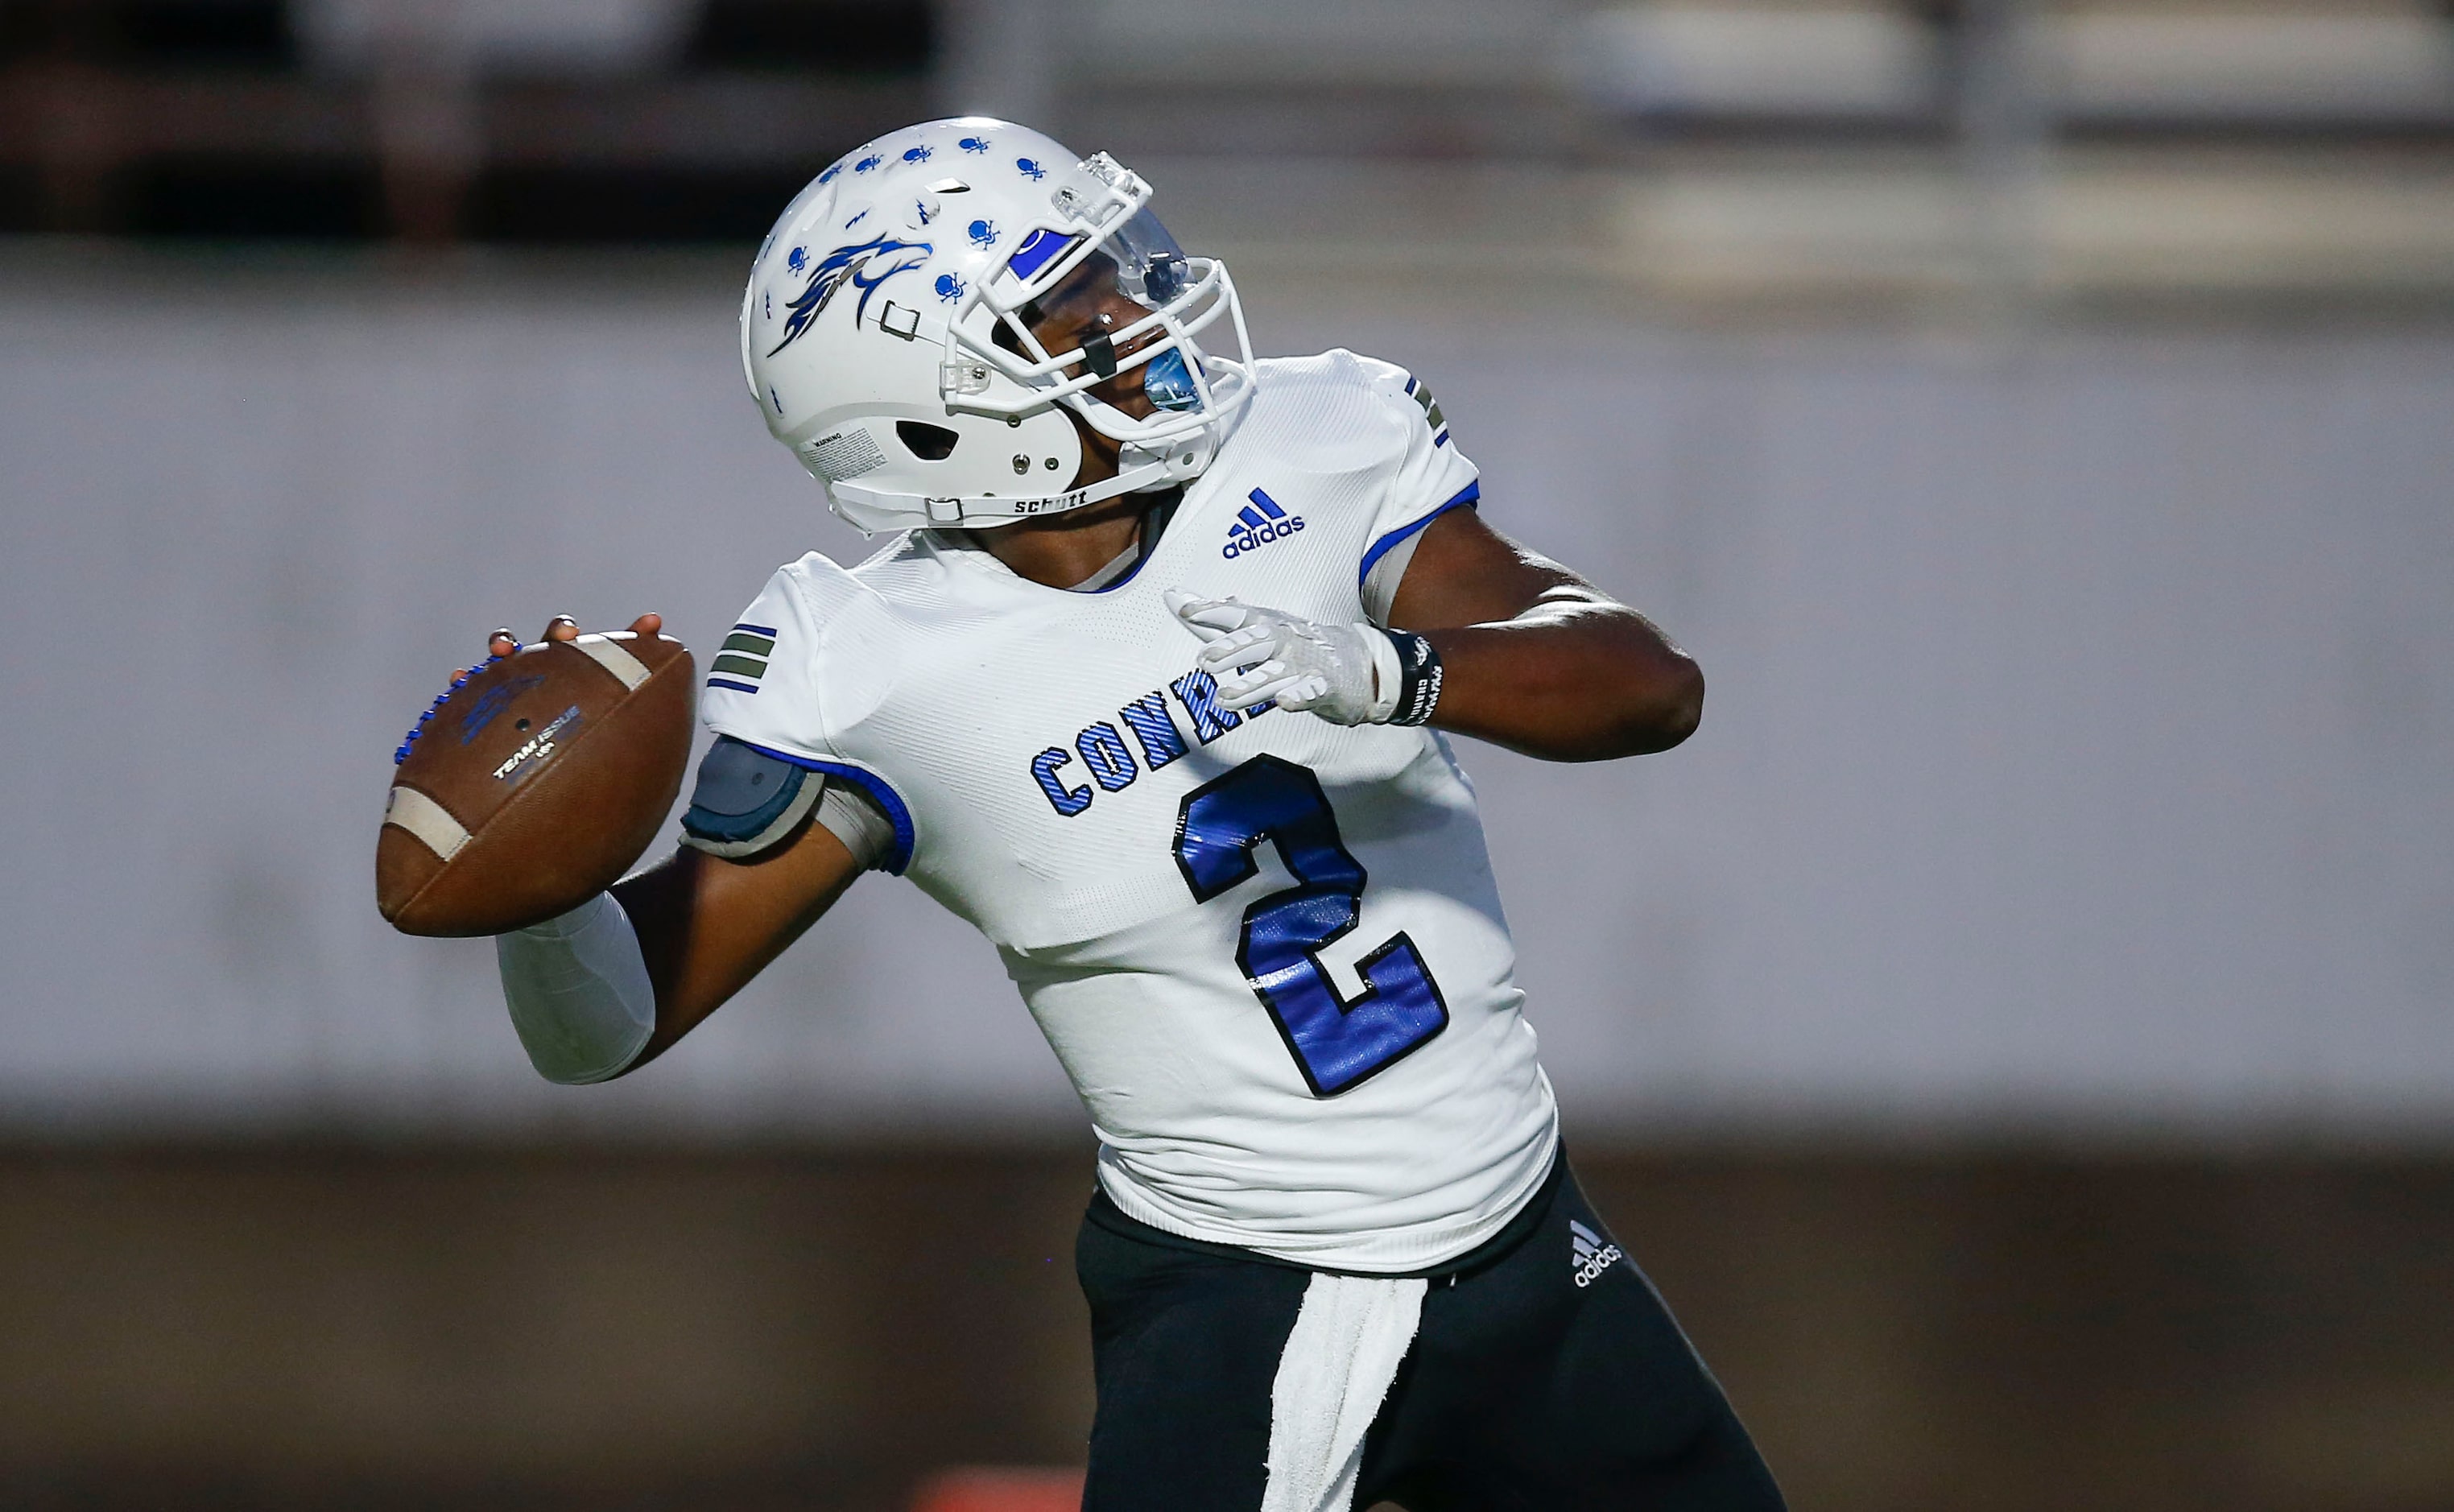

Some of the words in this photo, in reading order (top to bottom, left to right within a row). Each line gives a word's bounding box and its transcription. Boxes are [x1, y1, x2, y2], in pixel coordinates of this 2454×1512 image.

[1014, 490, 1087, 513] schutt
[1223, 516, 1305, 559] adidas
[493, 738, 537, 780] TEAM
[538, 704, 581, 744] ISSUE
[1031, 667, 1278, 817] CONR
[1171, 753, 1449, 1099] 2
[1575, 1244, 1622, 1288] adidas
